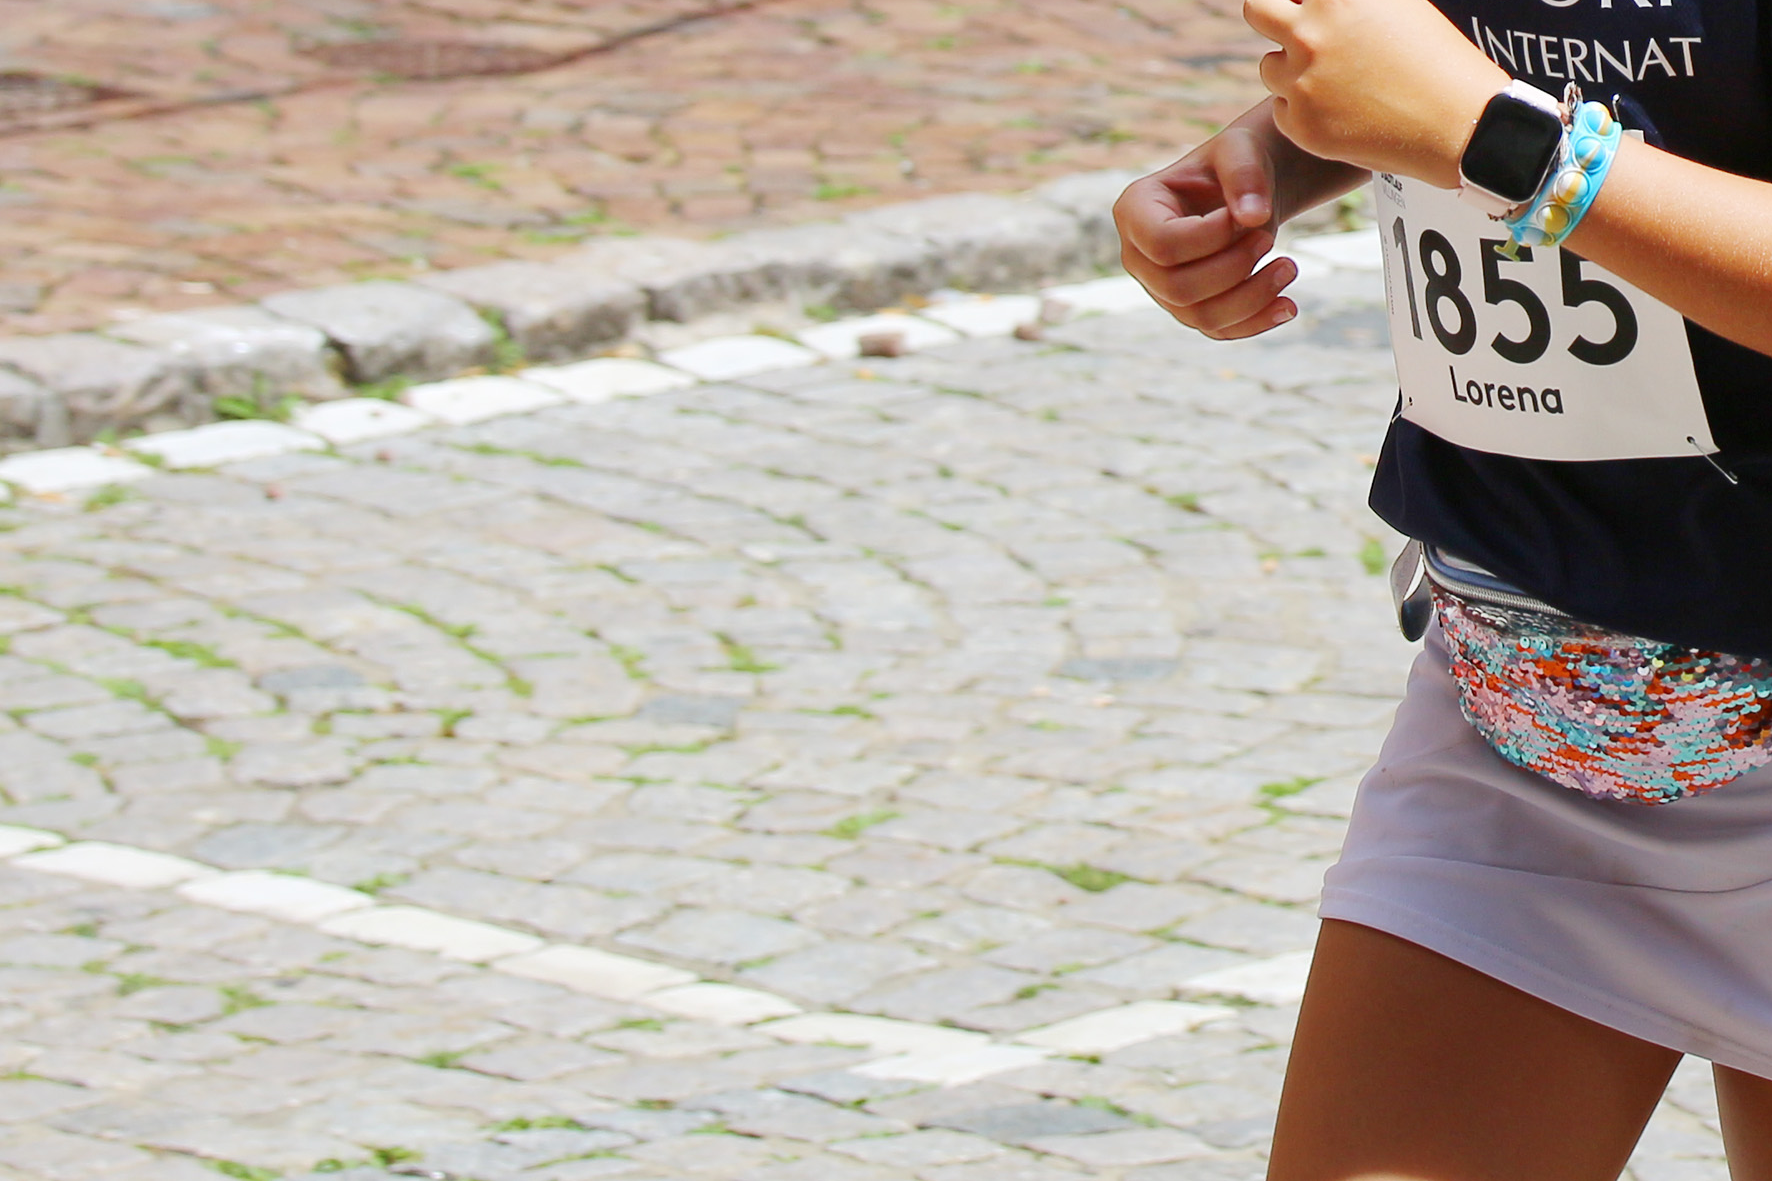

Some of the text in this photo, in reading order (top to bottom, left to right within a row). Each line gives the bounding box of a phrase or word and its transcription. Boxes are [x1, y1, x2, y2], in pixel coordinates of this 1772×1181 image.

[1471, 16, 1702, 83] INTERNAT
[1392, 215, 1639, 366] 1855
[1449, 365, 1564, 415] Lorena
